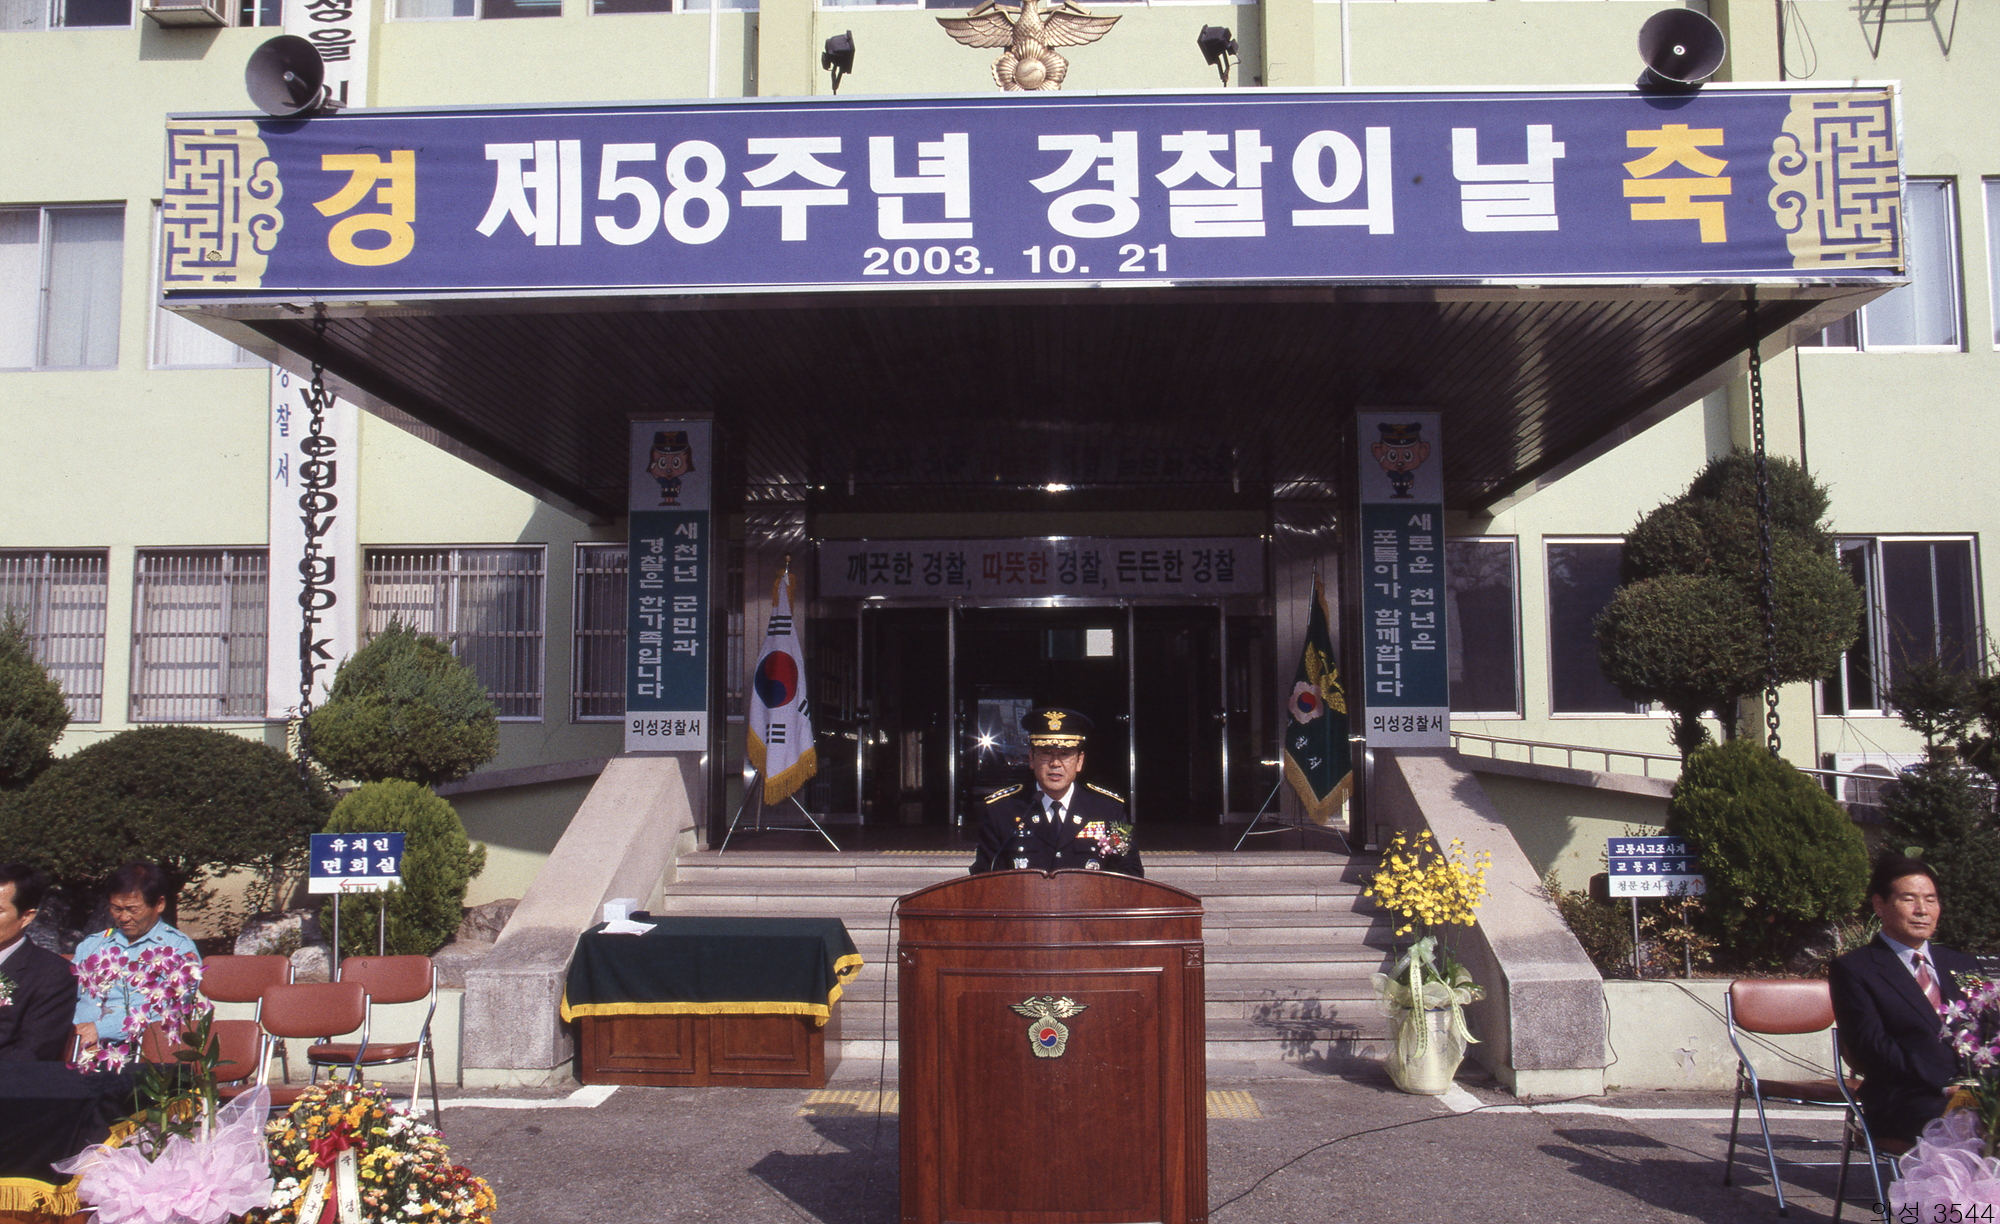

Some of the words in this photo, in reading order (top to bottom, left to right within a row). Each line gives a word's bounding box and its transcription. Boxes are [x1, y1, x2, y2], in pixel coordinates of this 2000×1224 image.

[314, 149, 416, 266] 경
[476, 132, 974, 246] 제58주년
[1029, 126, 1395, 239] 경찰의
[1451, 124, 1566, 233] 날
[1623, 124, 1732, 243] 축
[863, 246, 994, 275] 2003.
[1022, 245, 1090, 274] 10.
[1118, 244, 1168, 272] 21
[639, 537, 667, 589] 경찰은
[846, 551, 913, 586] 깨끗한
[922, 551, 972, 590] 경찰,
[982, 551, 1048, 586] 따뜻한
[1057, 550, 1107, 590] 경찰,
[1116, 549, 1184, 585] 든든한
[1191, 548, 1236, 584] 경찰
[1408, 513, 1434, 574] 새로운
[637, 596, 666, 699] 한가족입니다
[672, 596, 700, 657] 군민과
[1410, 588, 1436, 651] 천년은
[1374, 608, 1404, 697] 함께합니다
[632, 719, 701, 736] 의성경찰서
[1373, 715, 1443, 733] 의성경찰서
[321, 857, 396, 875] 면회실
